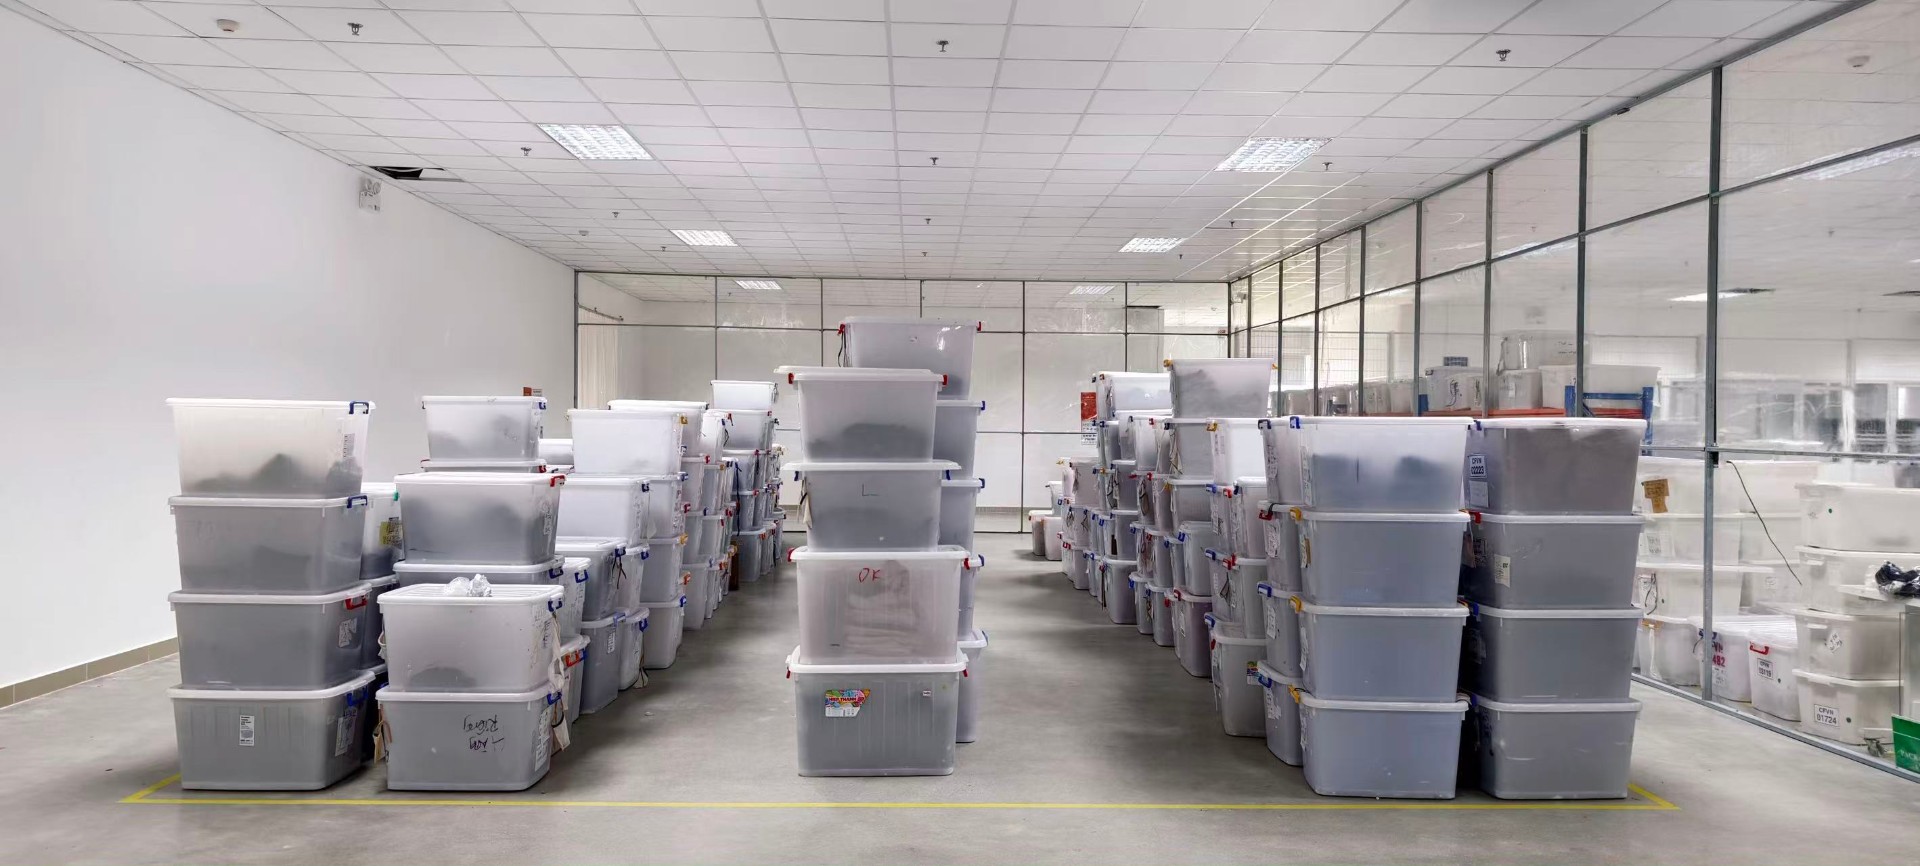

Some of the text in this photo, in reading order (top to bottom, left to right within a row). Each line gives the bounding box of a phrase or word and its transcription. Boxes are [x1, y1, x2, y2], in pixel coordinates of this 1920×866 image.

[858, 567, 881, 583] OK
[1818, 707, 1834, 715] CFVN
[1816, 714, 1837, 724] 01724
